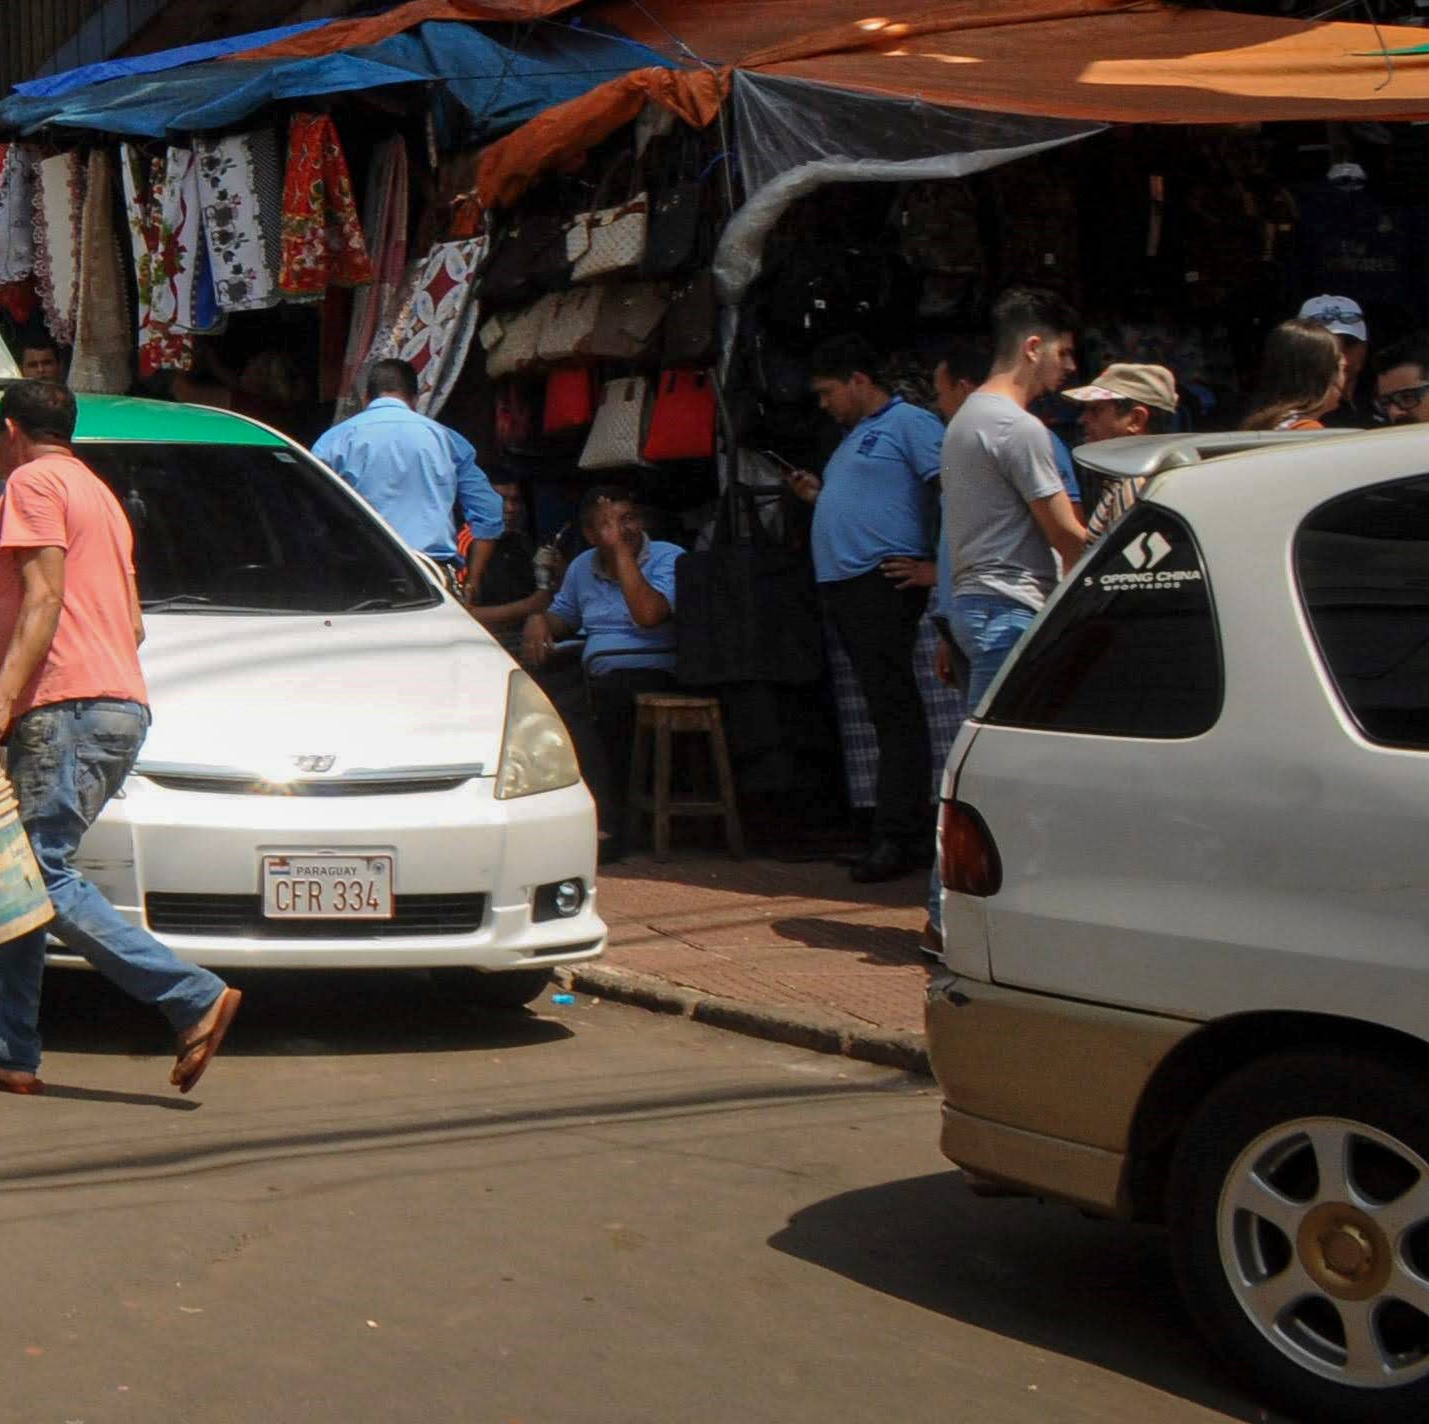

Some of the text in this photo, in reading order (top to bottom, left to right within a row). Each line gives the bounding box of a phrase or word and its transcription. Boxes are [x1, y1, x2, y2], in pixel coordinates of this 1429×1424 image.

[1155, 569, 1202, 582] CHINA
[296, 865, 358, 877] PARAGUAY
[276, 879, 380, 912] CFR 334
